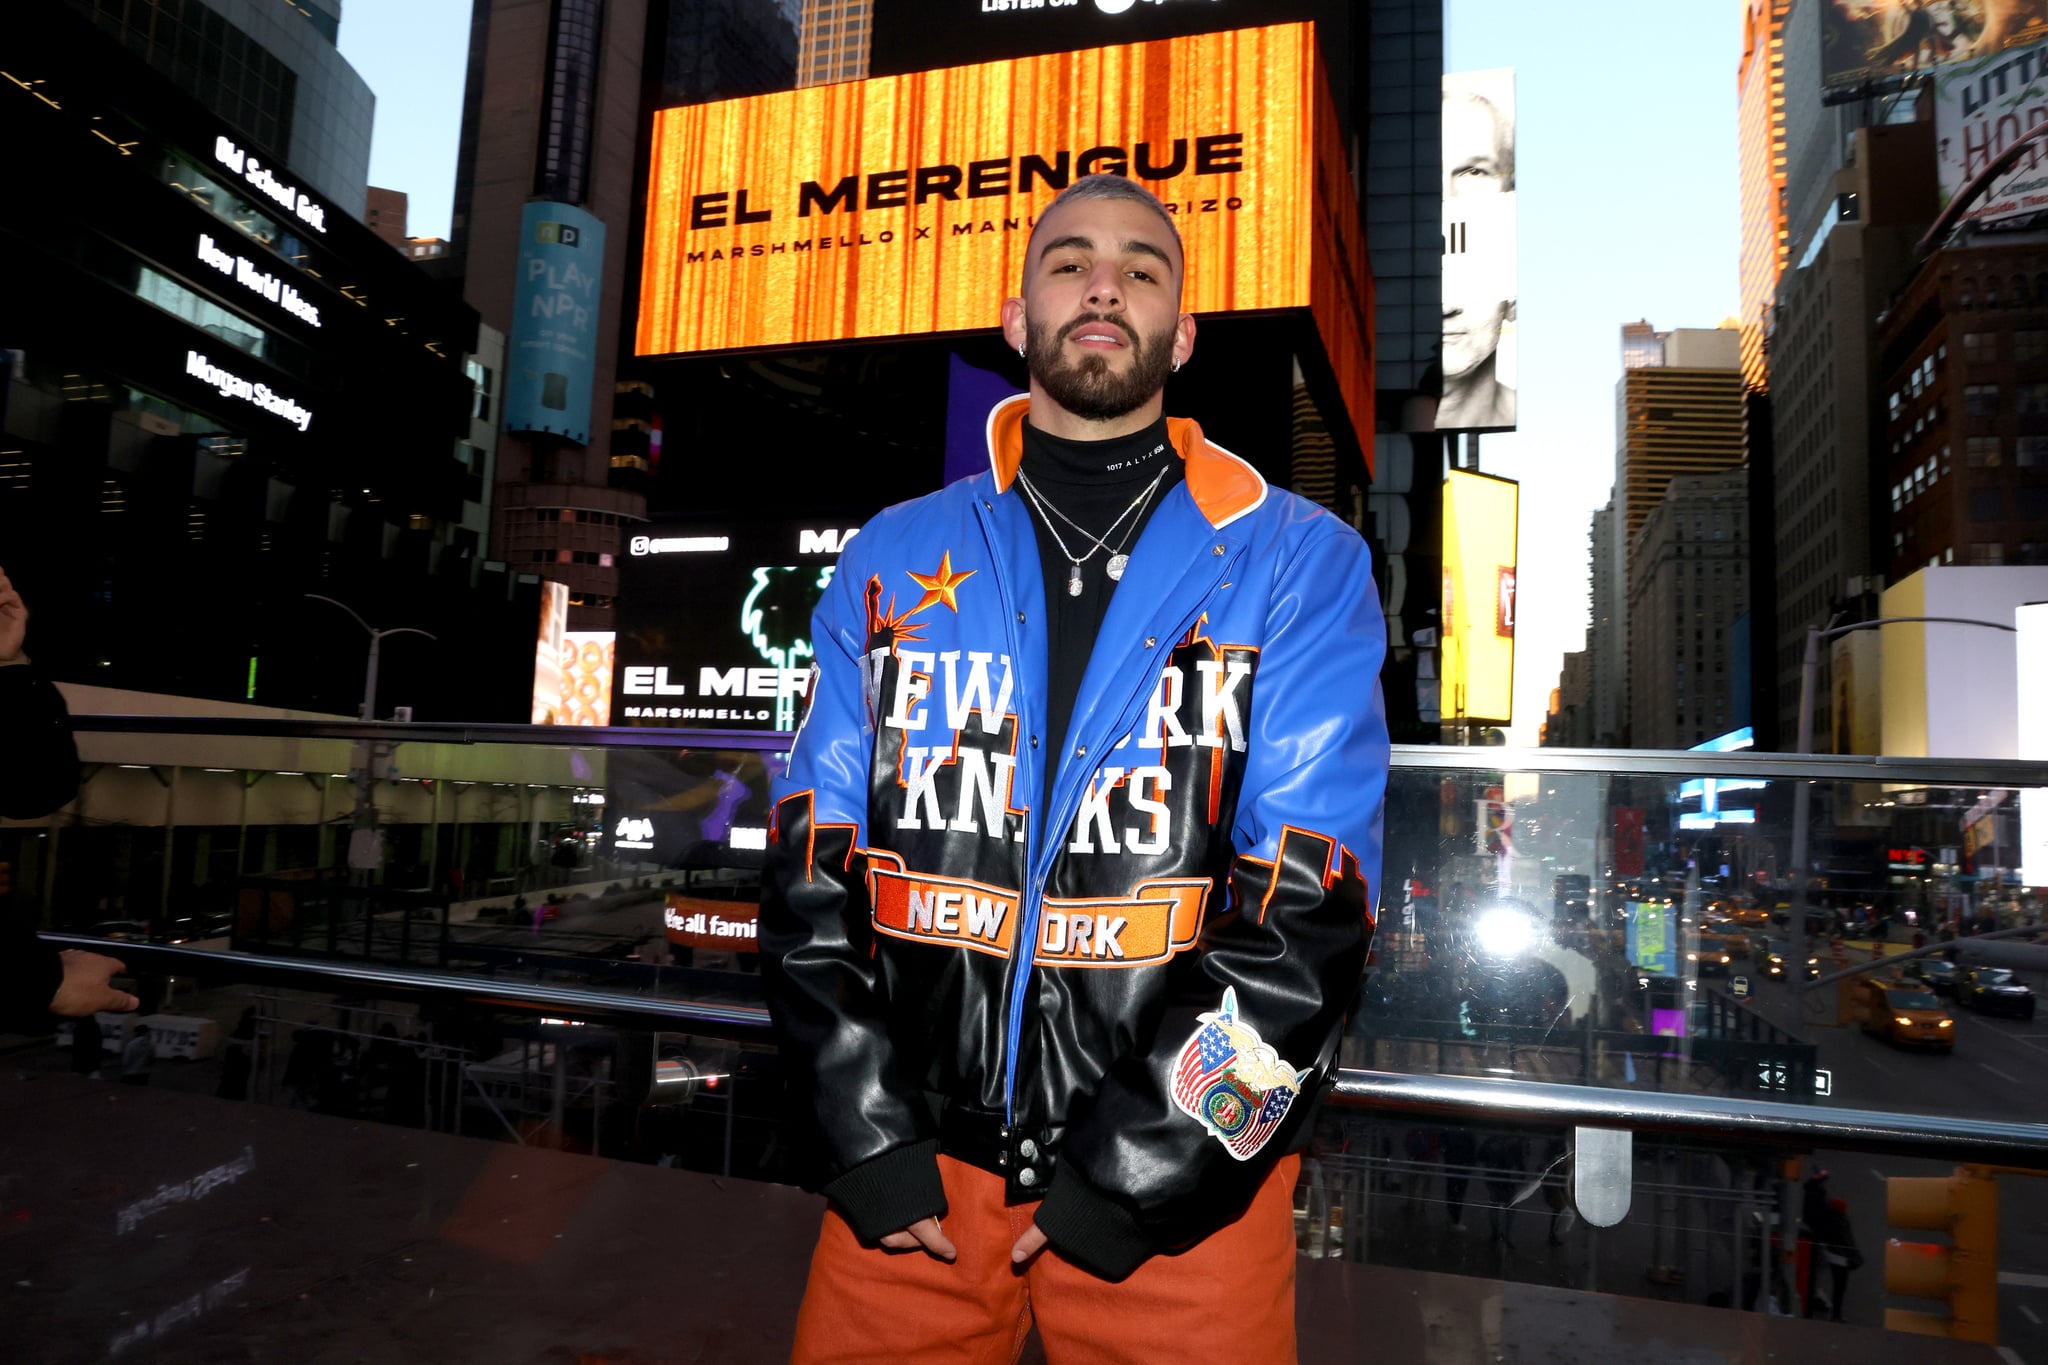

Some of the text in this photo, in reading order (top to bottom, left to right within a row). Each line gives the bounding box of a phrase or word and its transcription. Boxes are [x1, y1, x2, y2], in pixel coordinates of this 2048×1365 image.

[245, 157, 296, 211] School
[691, 133, 1243, 230] EL MERENGUE
[687, 230, 893, 263] MARSHMELLO
[914, 226, 931, 240] X
[1167, 197, 1243, 214] RIZO
[1441, 222, 1466, 255] ll
[198, 234, 235, 275] New
[237, 256, 280, 302] World
[186, 350, 312, 431] Morgan Stanley
[1106, 462, 1123, 471] 1017
[623, 666, 685, 695] EL
[858, 646, 1251, 753] NEW RK
[624, 706, 770, 720] MARSHMELLO
[685, 913, 707, 935] all
[907, 890, 1127, 957] NEW ORK
